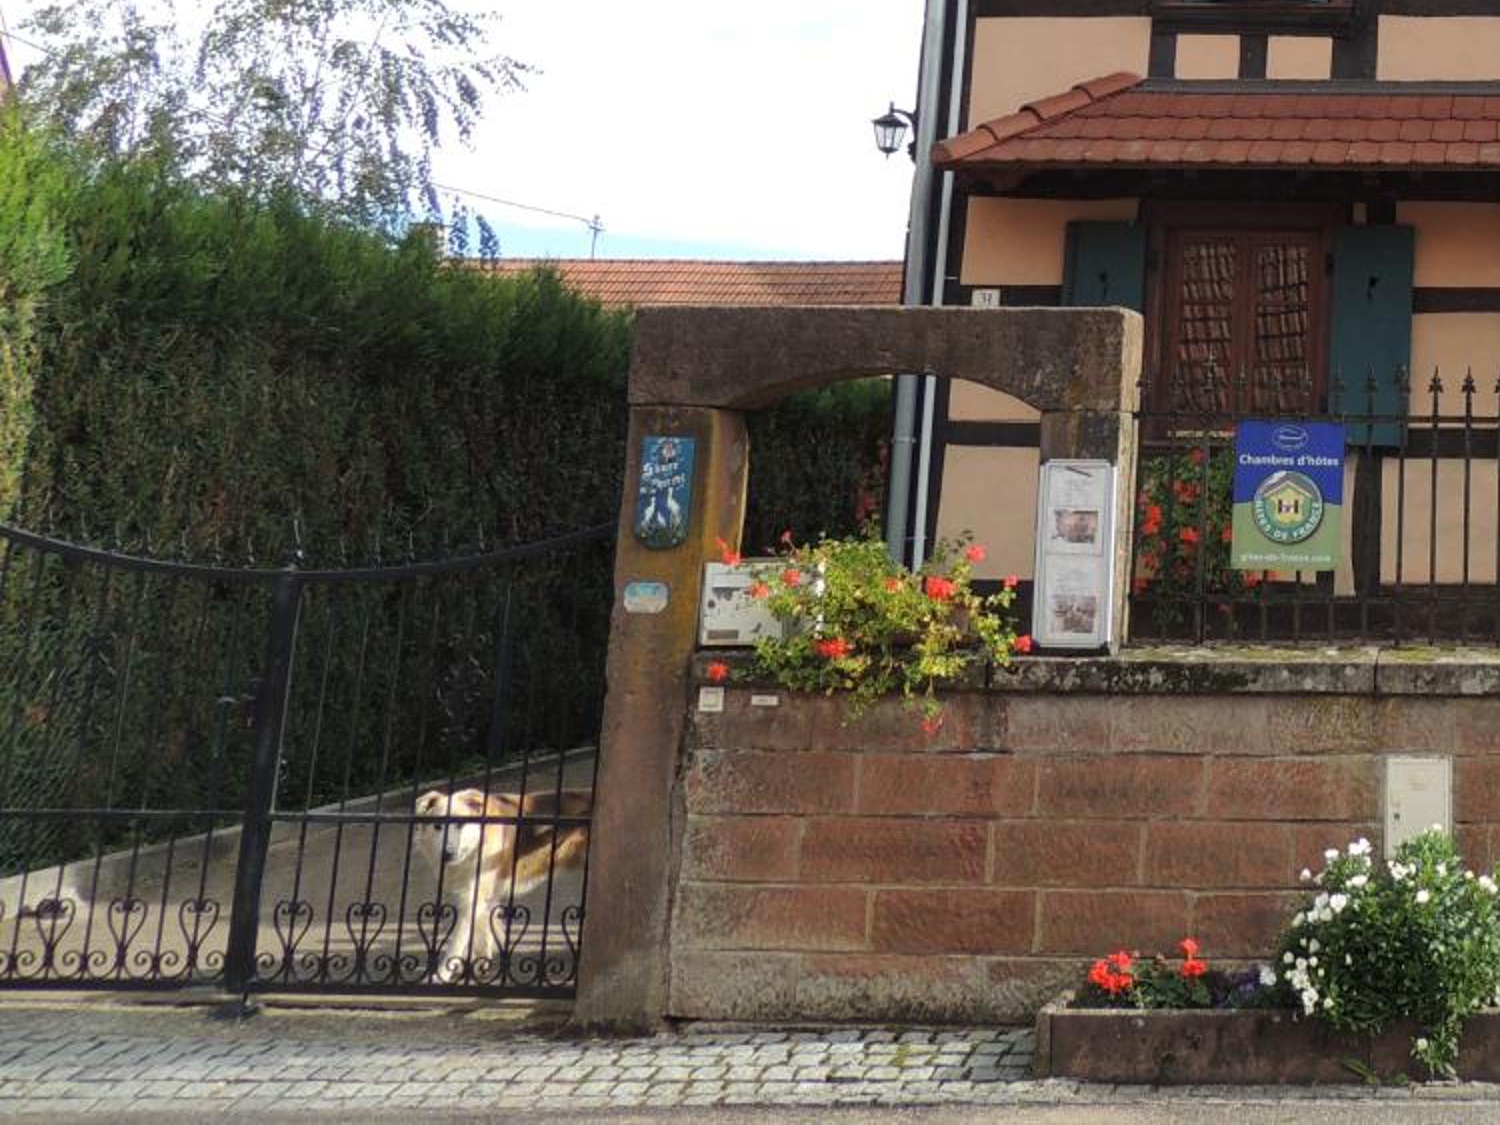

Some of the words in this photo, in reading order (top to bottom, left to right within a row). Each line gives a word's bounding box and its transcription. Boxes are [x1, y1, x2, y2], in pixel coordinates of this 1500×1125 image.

[1239, 453, 1294, 466] Chambres
[1297, 455, 1339, 467] d'hôtes
[1273, 530, 1289, 540] DE
[1293, 502, 1320, 538] FRANCE
